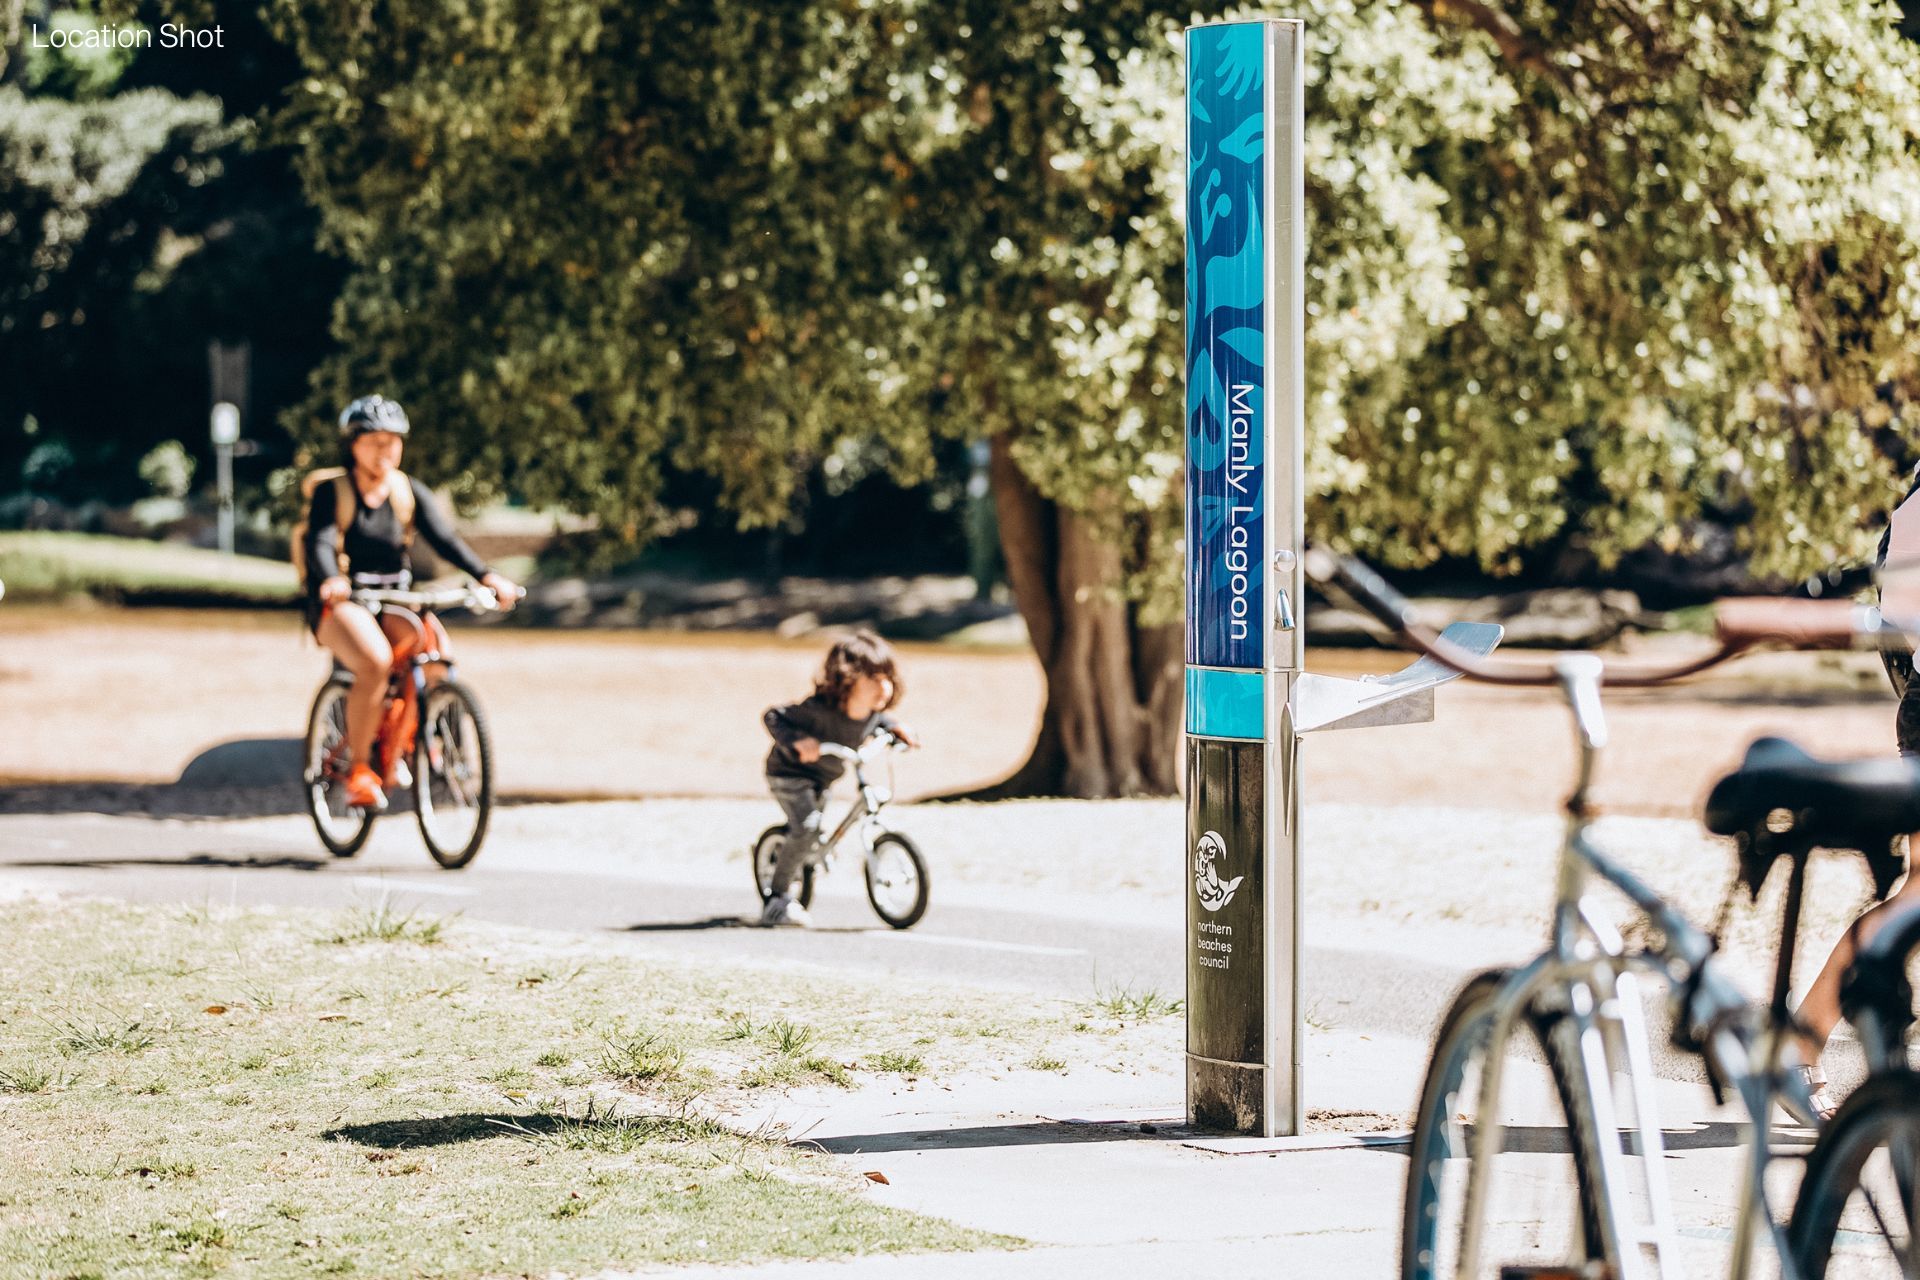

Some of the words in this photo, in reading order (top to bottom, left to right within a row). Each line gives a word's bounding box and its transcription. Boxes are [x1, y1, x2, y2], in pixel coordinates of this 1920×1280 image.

[1226, 384, 1254, 494] Manly
[1226, 506, 1254, 640] Lagoon
[1197, 920, 1232, 936] northern
[1197, 935, 1232, 953] beaches
[1199, 955, 1229, 969] council
